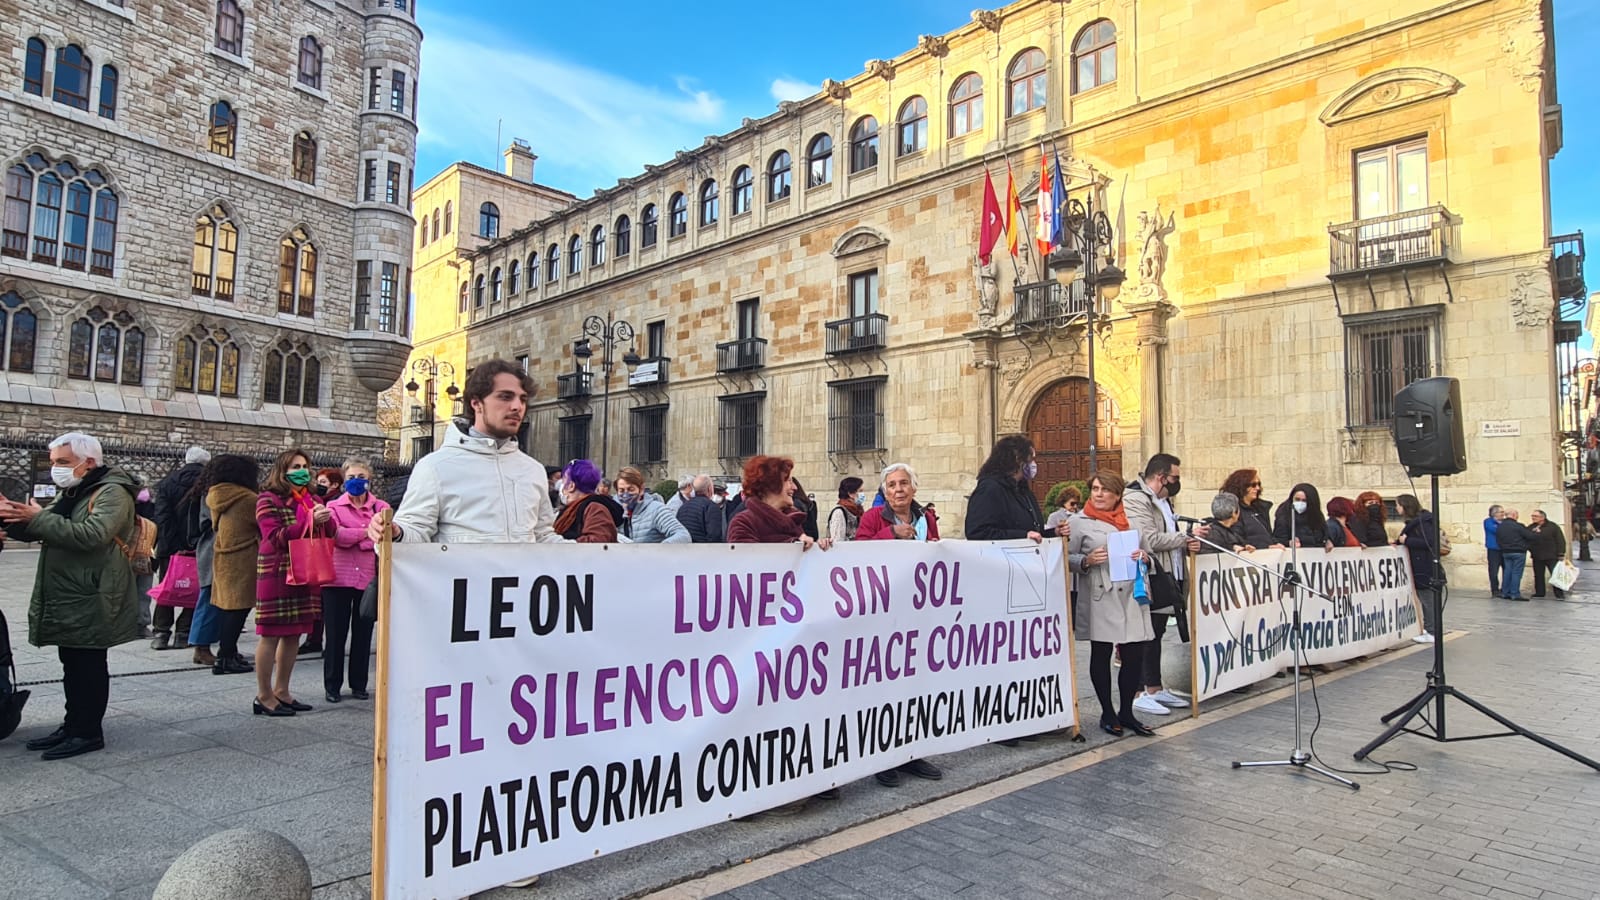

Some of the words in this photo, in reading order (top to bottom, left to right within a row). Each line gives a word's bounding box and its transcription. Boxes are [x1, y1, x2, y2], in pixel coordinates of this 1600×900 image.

[450, 573, 594, 643] LEON
[674, 570, 804, 634] LUNES
[829, 565, 890, 618] SIN
[912, 560, 964, 611] SOL
[1199, 564, 1273, 616] CONTRA
[1301, 558, 1377, 599] VIOLENCIA
[1332, 593, 1353, 619] LEON
[425, 682, 485, 762] EL
[507, 654, 739, 745] SILENCIO
[754, 641, 829, 706] NOS
[841, 629, 919, 689] HACE
[927, 610, 1062, 673] CÓMPLICES
[1213, 637, 1239, 689] por
[1337, 616, 1349, 647] en
[424, 752, 683, 878] PLATAFORMA
[696, 722, 814, 803] CONTRA
[822, 714, 849, 770] LA
[857, 689, 966, 758] VIOLENCIA
[971, 673, 1064, 729] MACHISTA
